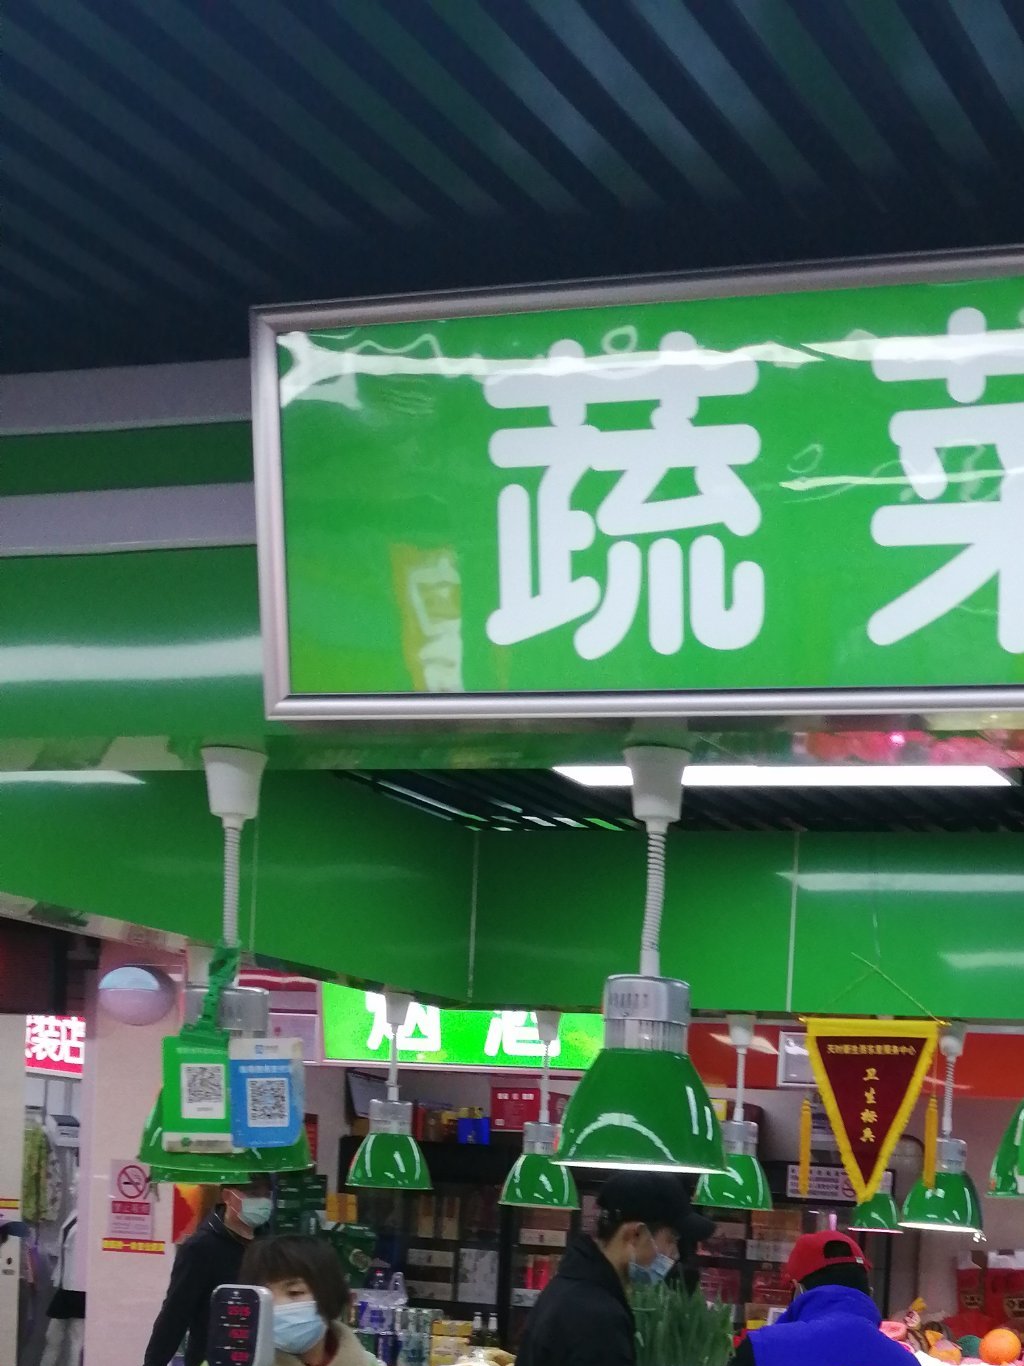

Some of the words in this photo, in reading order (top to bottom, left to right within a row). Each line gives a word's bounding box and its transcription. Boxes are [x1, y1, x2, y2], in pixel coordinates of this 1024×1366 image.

[25, 1015, 86, 1065] 装店
[859, 1067, 881, 1143] 卫生标兵
